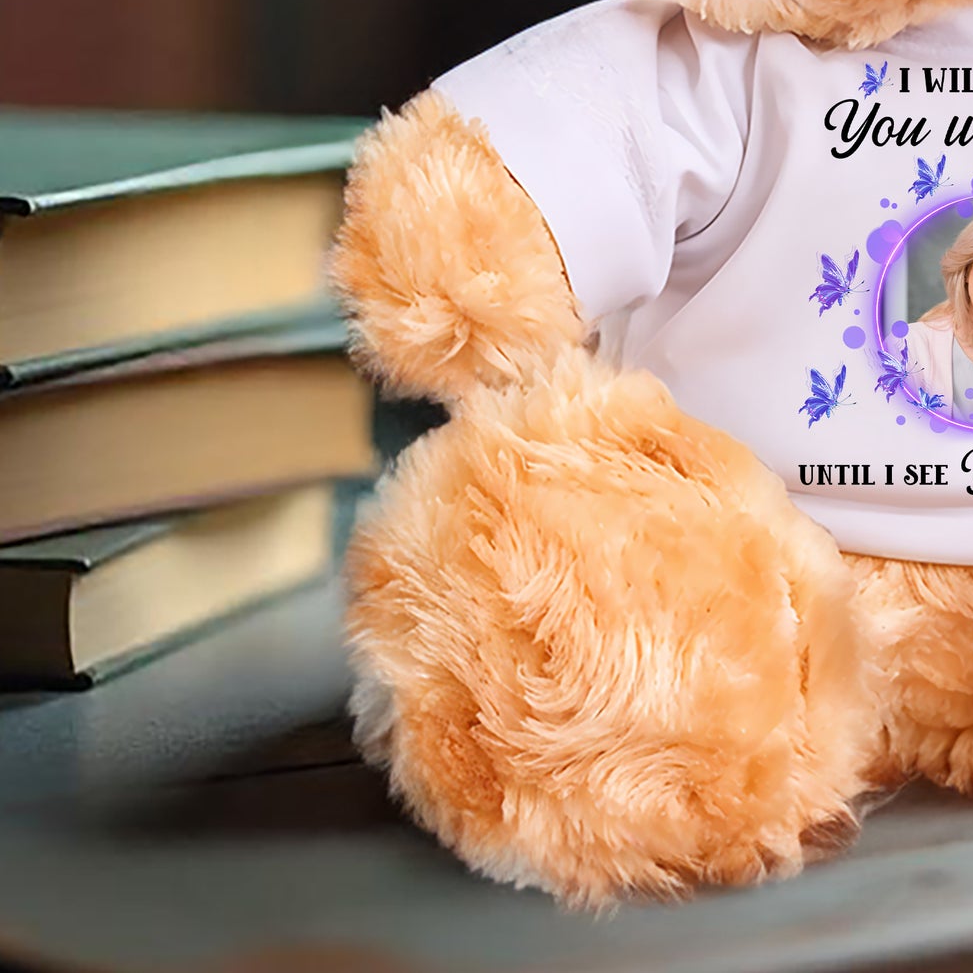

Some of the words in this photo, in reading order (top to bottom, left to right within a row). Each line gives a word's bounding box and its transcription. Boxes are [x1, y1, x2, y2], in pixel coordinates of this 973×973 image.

[899, 67, 910, 93] I
[824, 98, 932, 160] You
[798, 464, 876, 486] UNTIL
[884, 464, 894, 486] I
[903, 464, 949, 486] SEE
